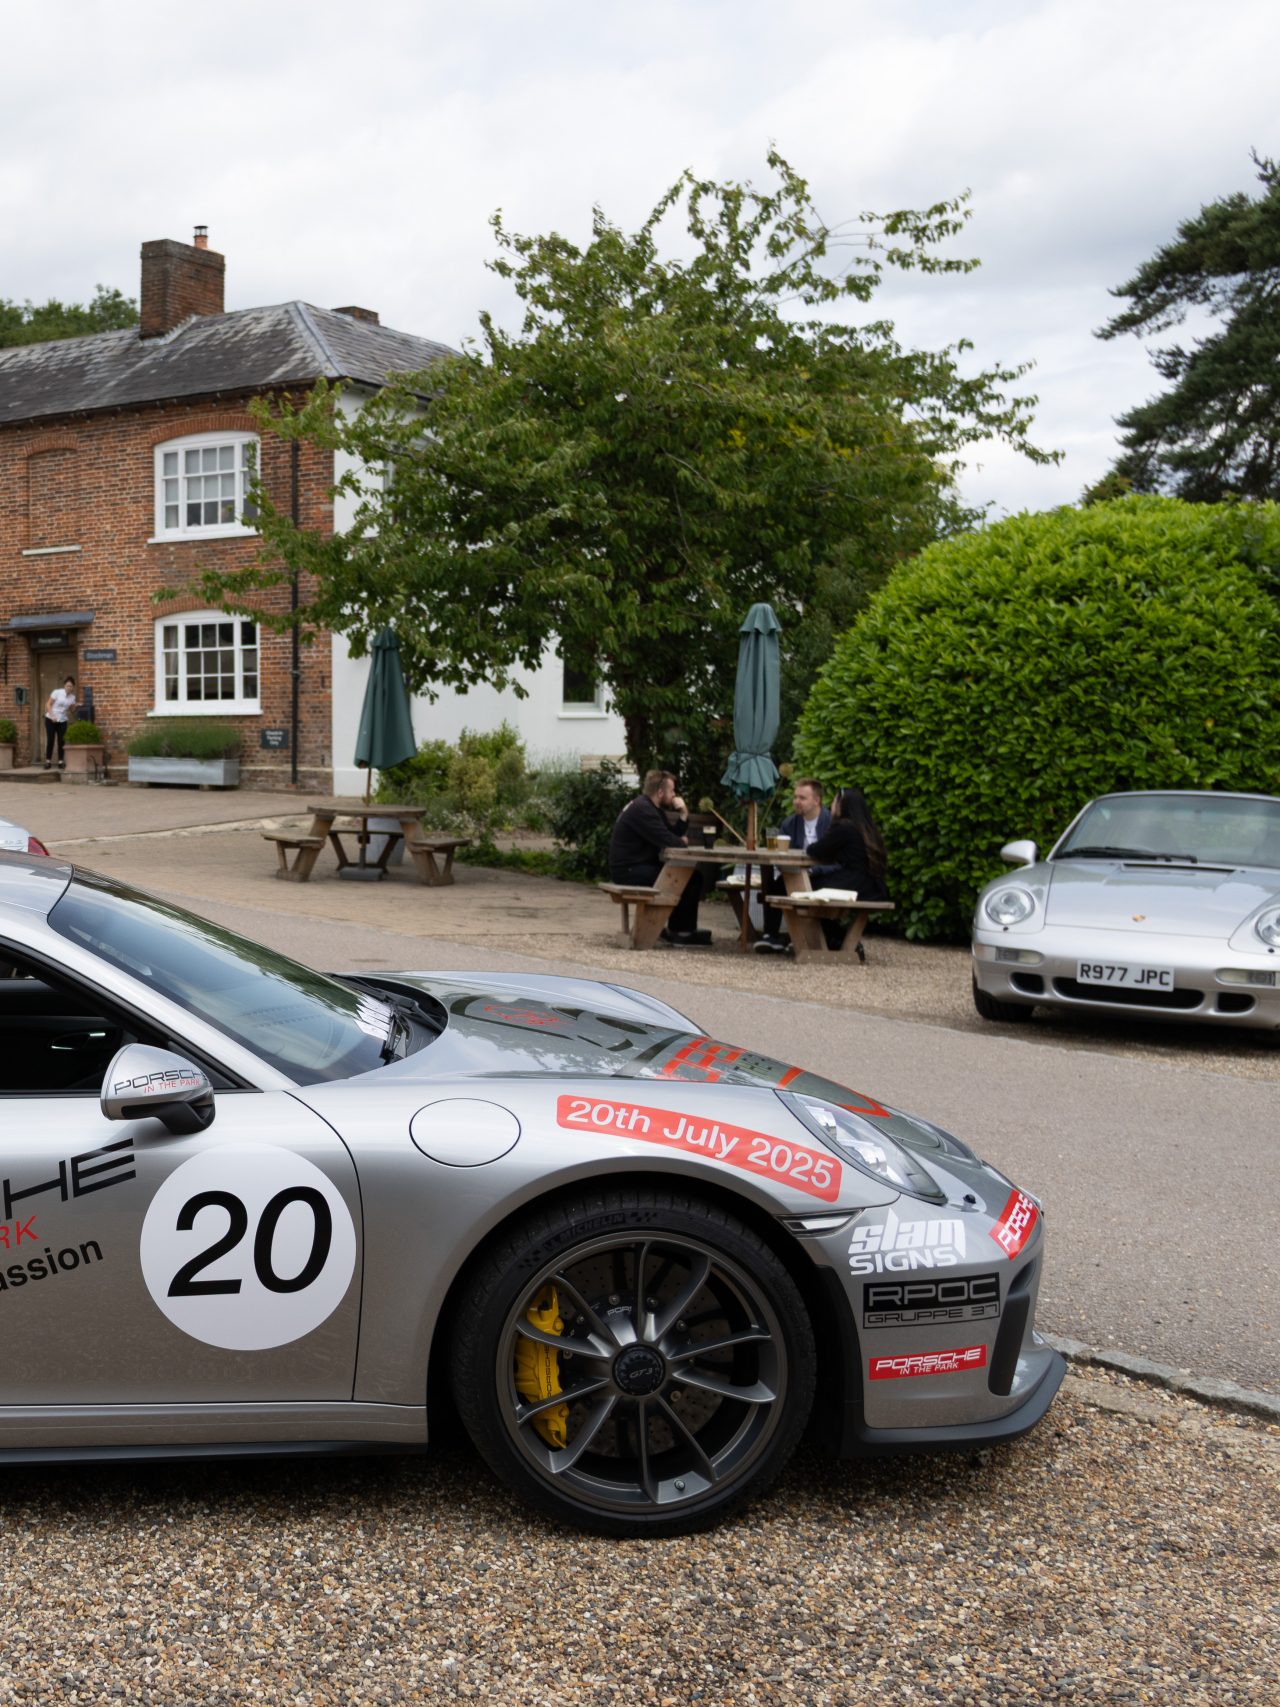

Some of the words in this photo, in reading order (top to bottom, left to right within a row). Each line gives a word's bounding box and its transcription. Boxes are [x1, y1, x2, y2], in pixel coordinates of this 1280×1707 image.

[1080, 963, 1128, 982] R977
[1134, 968, 1170, 986] JPC
[113, 1069, 208, 1095] PORSCH
[144, 1084, 155, 1094] IN
[159, 1080, 177, 1090] THE
[180, 1078, 201, 1088] PARK
[566, 1100, 651, 1133] 20th
[663, 1117, 740, 1159] July
[747, 1137, 834, 1189] 2025
[847, 1207, 966, 1259] slam
[997, 1192, 1034, 1251] PORSCHE
[167, 1185, 333, 1298] 20
[849, 1246, 959, 1275] SIGNS
[869, 1278, 998, 1307] RPOC
[867, 1308, 963, 1323] GRUPPE
[971, 1303, 998, 1316] 37
[875, 1348, 982, 1371] PORSCHE
[899, 1367, 910, 1375] IN
[913, 1364, 932, 1373] THE
[934, 1361, 959, 1371] PARK
[629, 1367, 653, 1379] GT3
